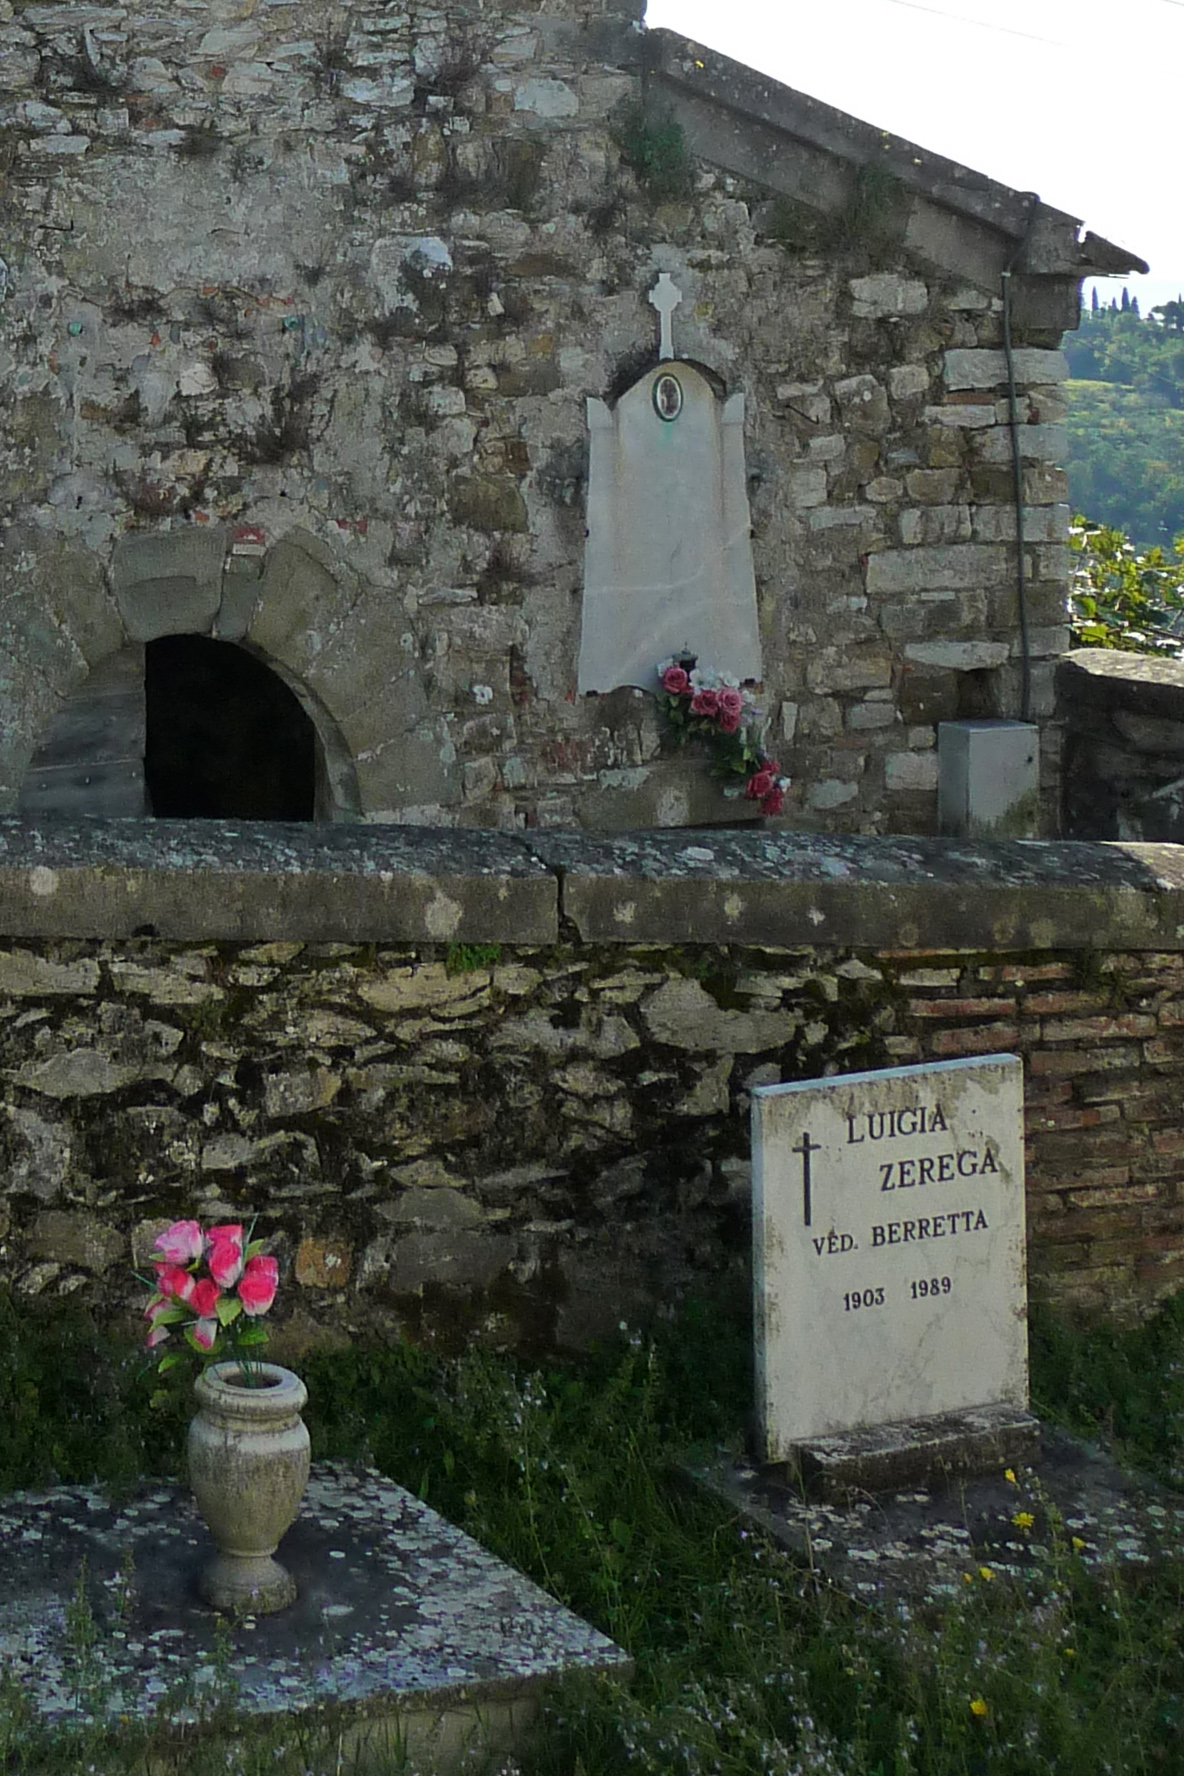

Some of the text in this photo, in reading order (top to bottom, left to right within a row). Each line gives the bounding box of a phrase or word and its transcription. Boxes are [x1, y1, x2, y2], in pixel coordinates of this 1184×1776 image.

[846, 1102, 949, 1144] LUIGIA
[879, 1146, 999, 1192] ZEREGA
[812, 1208, 989, 1256] VED. BERRETTA
[843, 1276, 952, 1311] 1903 1989
